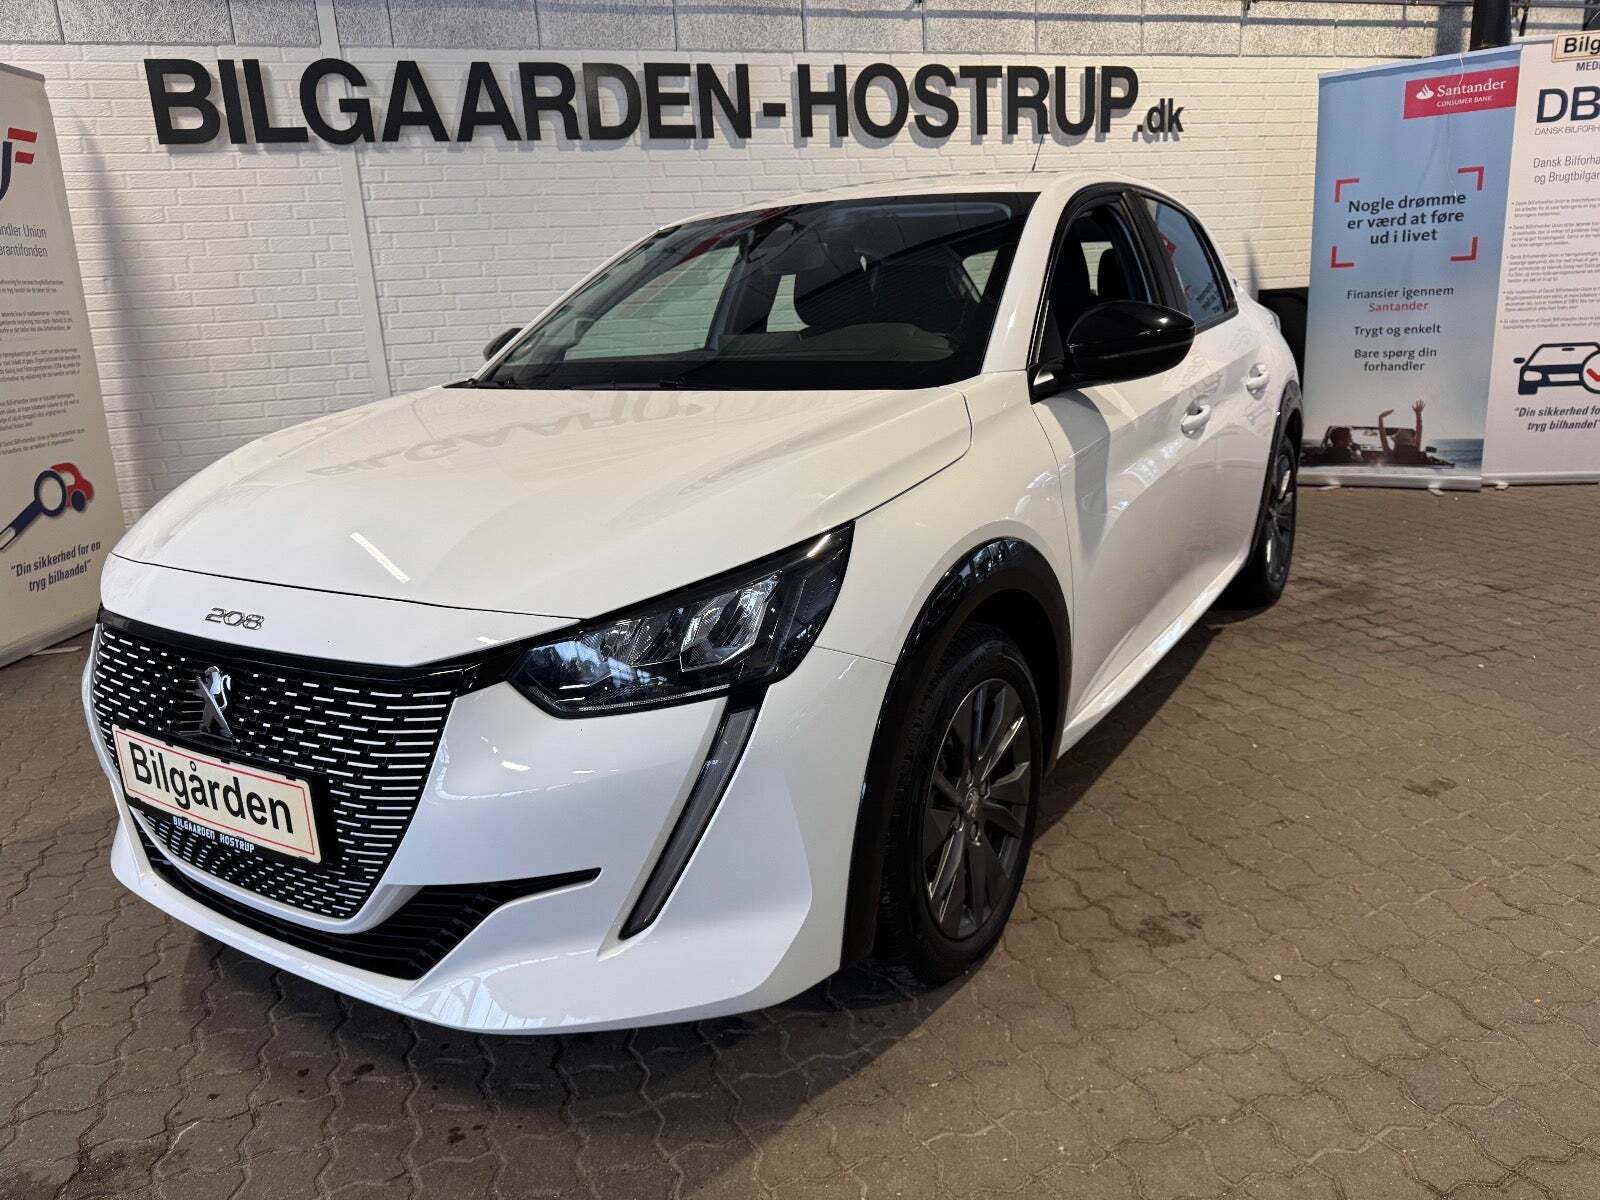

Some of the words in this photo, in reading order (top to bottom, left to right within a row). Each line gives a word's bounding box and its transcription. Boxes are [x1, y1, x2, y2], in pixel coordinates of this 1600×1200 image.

[1563, 36, 1600, 54] Bilg
[1436, 78, 1507, 97] Santander
[1436, 98, 1473, 108] CONSUMER
[1474, 95, 1492, 104] BANK
[1534, 126, 1564, 136] DANSK
[1533, 156, 1562, 169] Dansk
[1534, 174, 1546, 185] og
[1348, 197, 1394, 215] Nogle
[1398, 193, 1466, 209] drømme
[1347, 219, 1362, 229] er
[1367, 211, 1406, 228] værd
[1411, 211, 1426, 225] at
[1430, 209, 1464, 224] føre
[23, 224, 47, 239] Union
[1370, 230, 1389, 245] ud
[1393, 231, 1398, 243] i
[1402, 228, 1438, 243] livet
[1347, 288, 1400, 300] Finansier
[1402, 286, 1454, 299] igennem
[1368, 301, 1429, 313] Santander
[1354, 325, 1383, 338] Trygt
[1386, 326, 1400, 337] og
[1403, 323, 1441, 335] enkelt
[1354, 348, 1379, 359] Bare
[1383, 348, 1415, 361] spørg
[1418, 347, 1437, 357] din
[1364, 360, 1425, 372] forhandler
[1538, 406, 1588, 417] sikkerhed
[1527, 422, 1546, 432] tryg
[33, 549, 76, 571] sikkerhed
[77, 544, 90, 556] for
[91, 541, 101, 552] en
[29, 577, 46, 592] tryg
[205, 607, 265, 631] 208
[128, 740, 294, 835] Bilgården
[173, 815, 215, 841] BILGAARDEN
[219, 831, 255, 853] HOSTRUP
